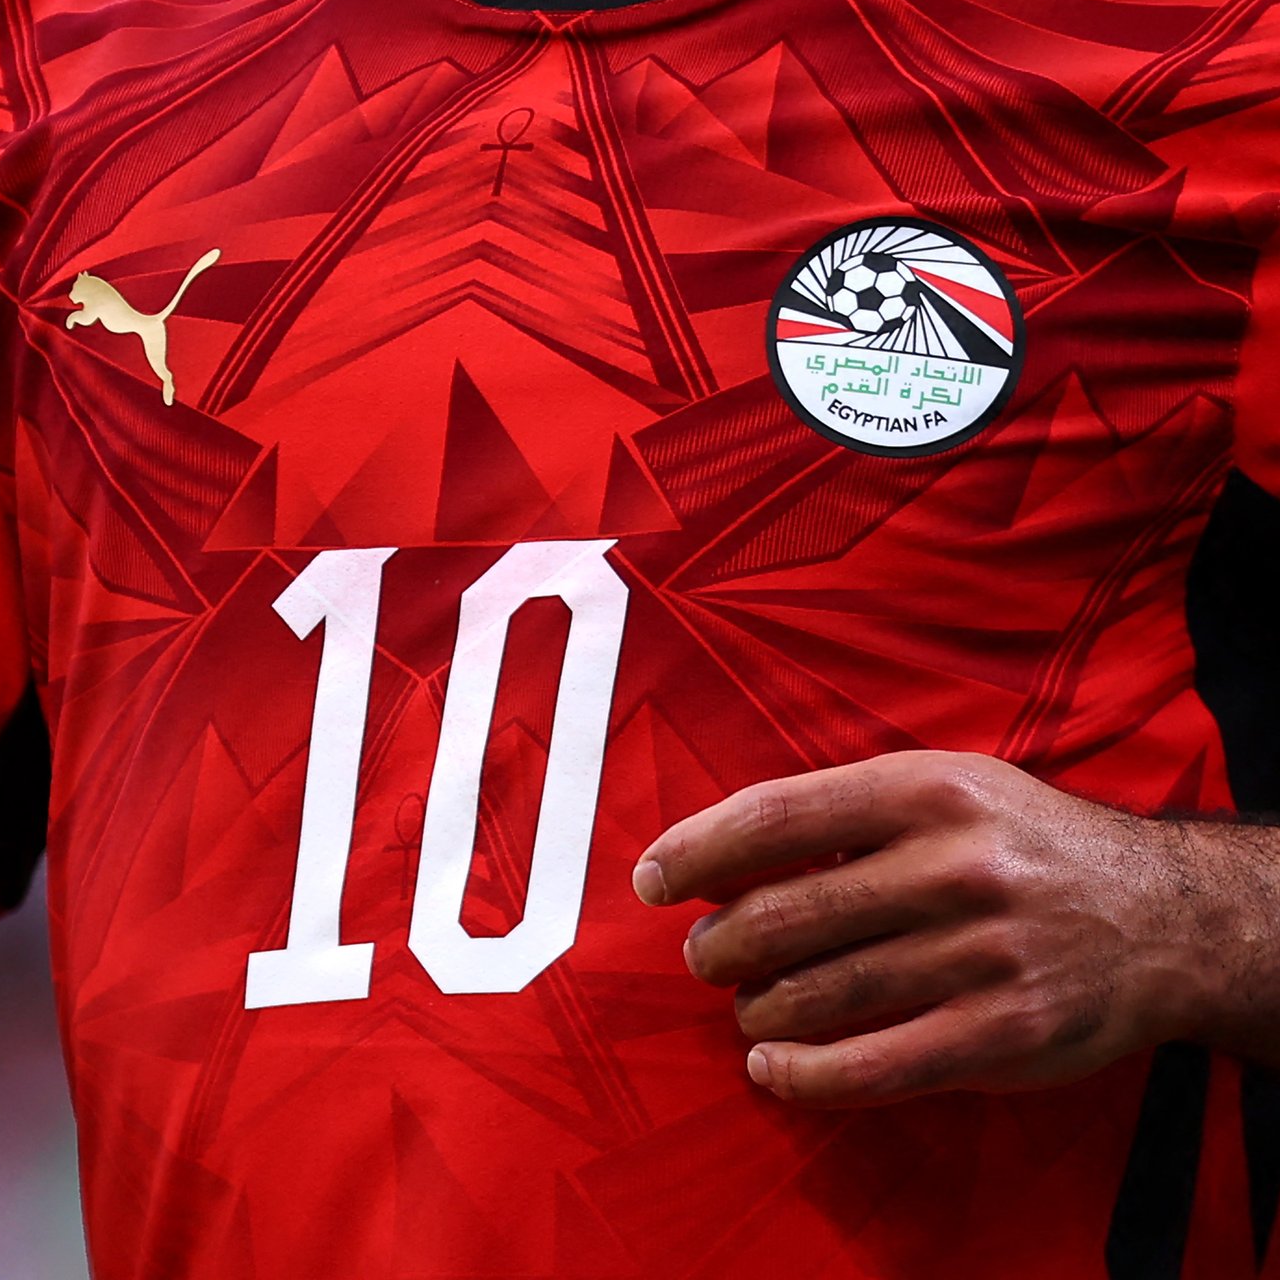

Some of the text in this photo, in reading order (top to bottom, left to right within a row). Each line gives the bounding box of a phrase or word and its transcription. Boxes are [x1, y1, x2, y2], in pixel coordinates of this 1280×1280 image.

[806, 355, 982, 386] الاتحاد المصري
[821, 377, 963, 410] لكرة القدم
[827, 399, 948, 432] EGYPTIAN FA
[244, 538, 630, 1010] 10
